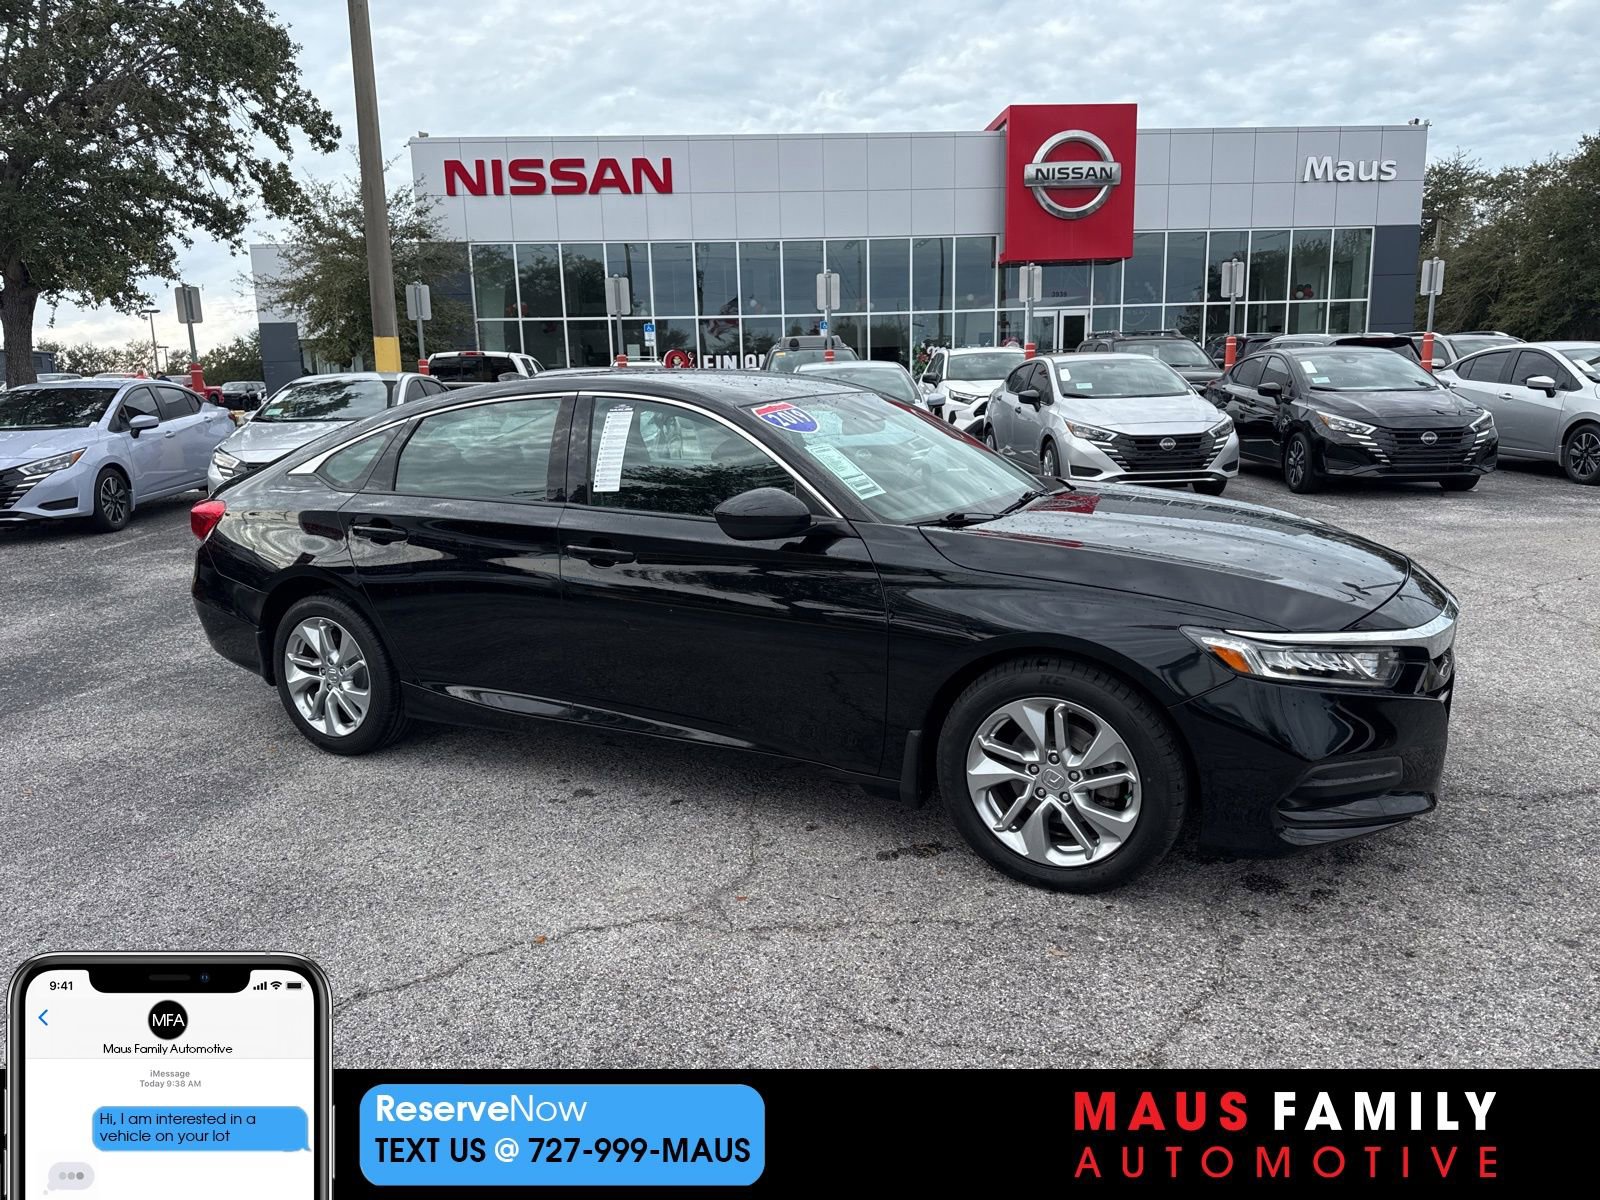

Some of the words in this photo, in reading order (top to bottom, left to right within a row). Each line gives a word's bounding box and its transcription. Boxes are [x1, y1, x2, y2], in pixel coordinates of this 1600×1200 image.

[444, 158, 673, 197] NISSAN
[1035, 166, 1113, 181] NISSAN
[1303, 156, 1397, 182] Maus
[768, 409, 812, 427] 2019
